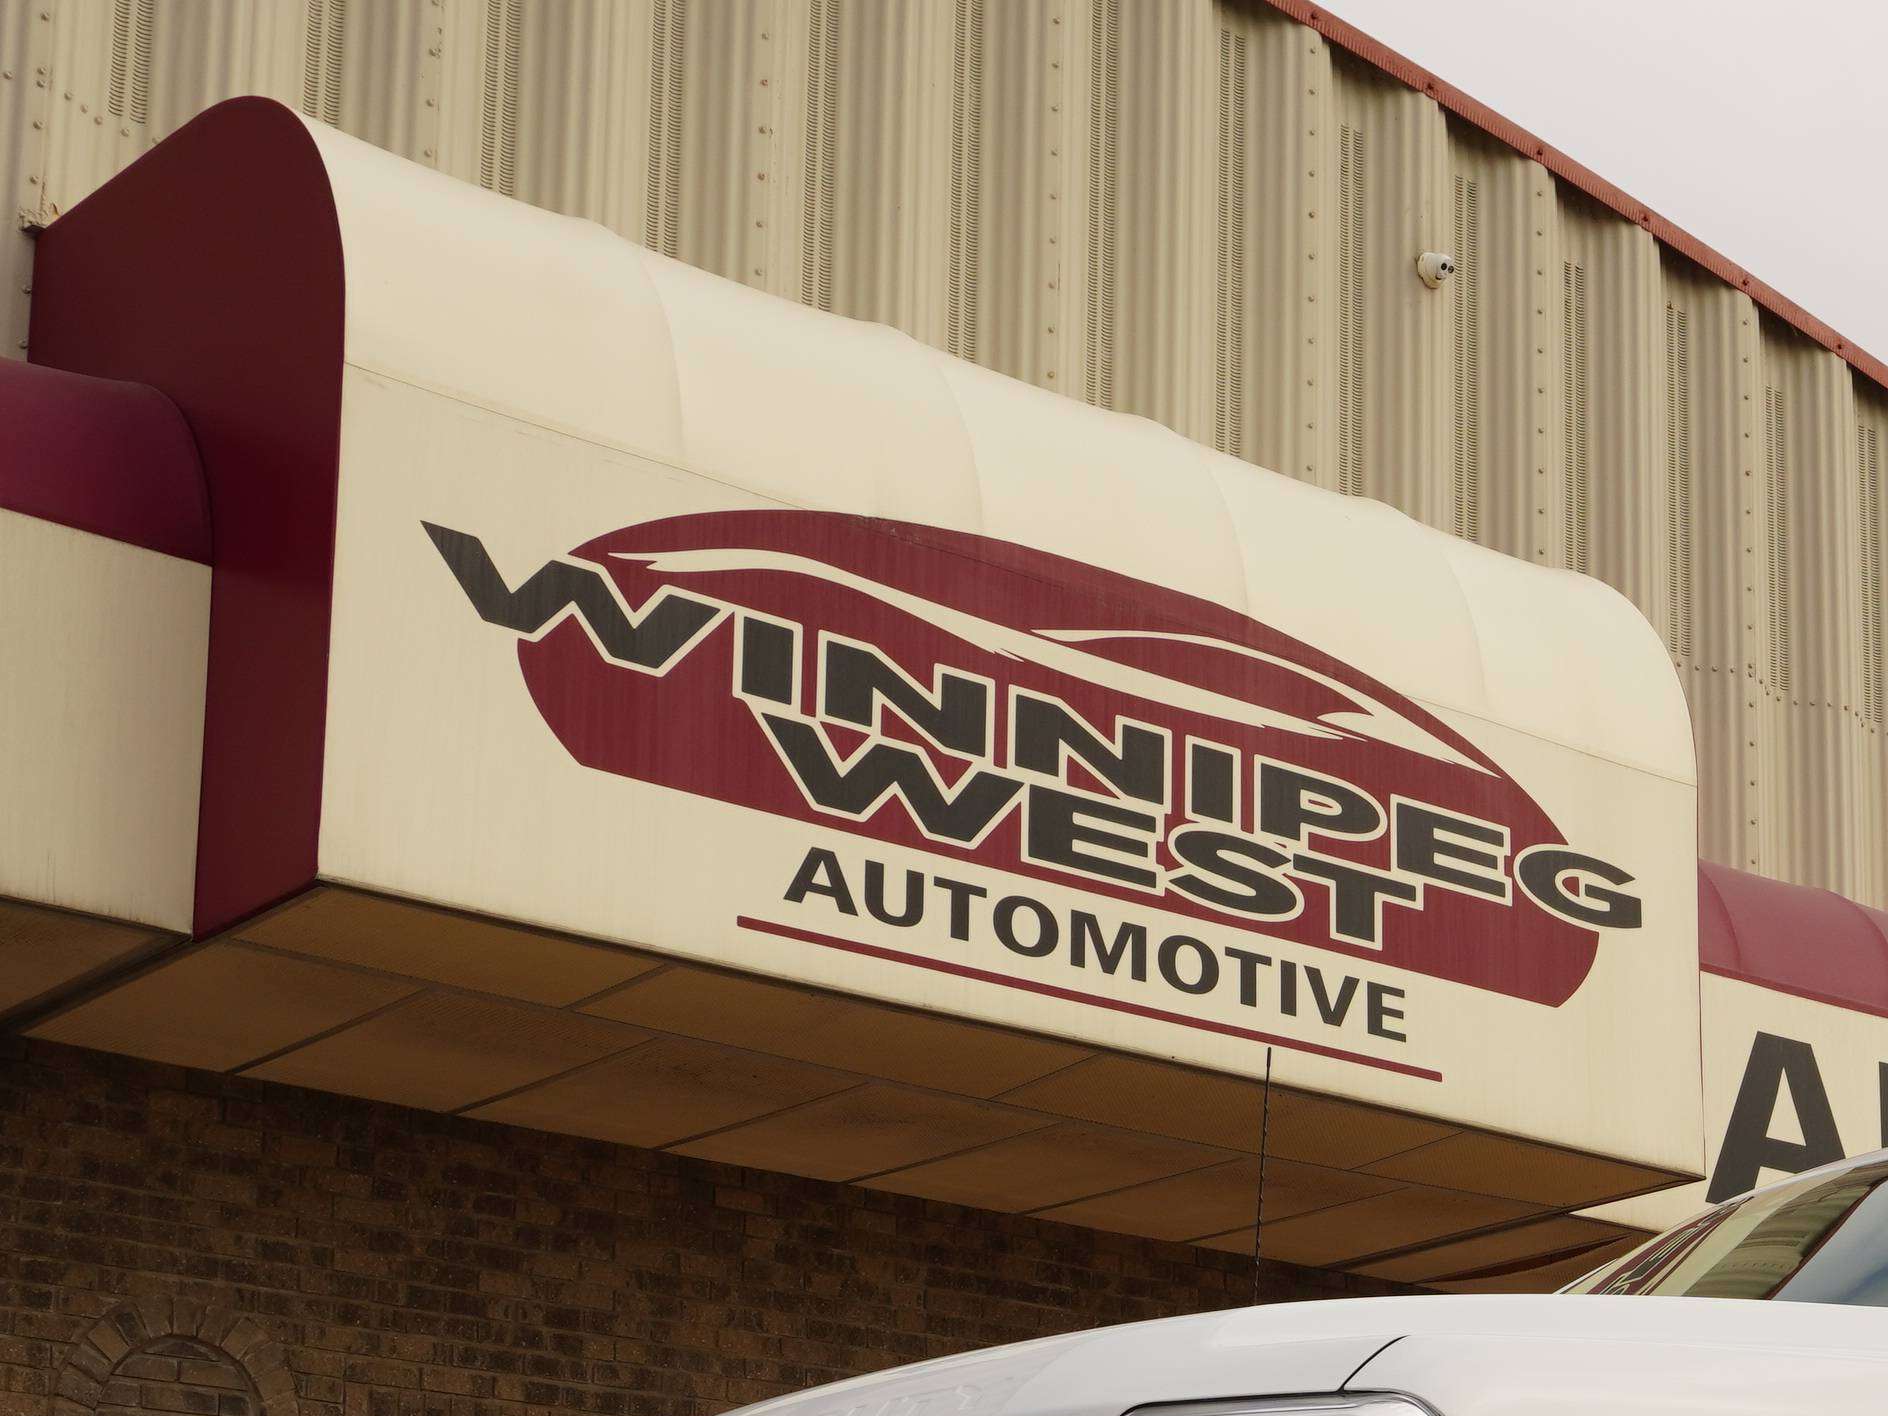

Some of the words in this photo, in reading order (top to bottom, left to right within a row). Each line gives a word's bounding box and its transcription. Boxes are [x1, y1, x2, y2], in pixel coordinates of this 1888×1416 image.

[419, 520, 1643, 930] WINNIPEG
[761, 711, 1420, 950] WEST
[783, 846, 1408, 1043] AUTOMOTIVE
